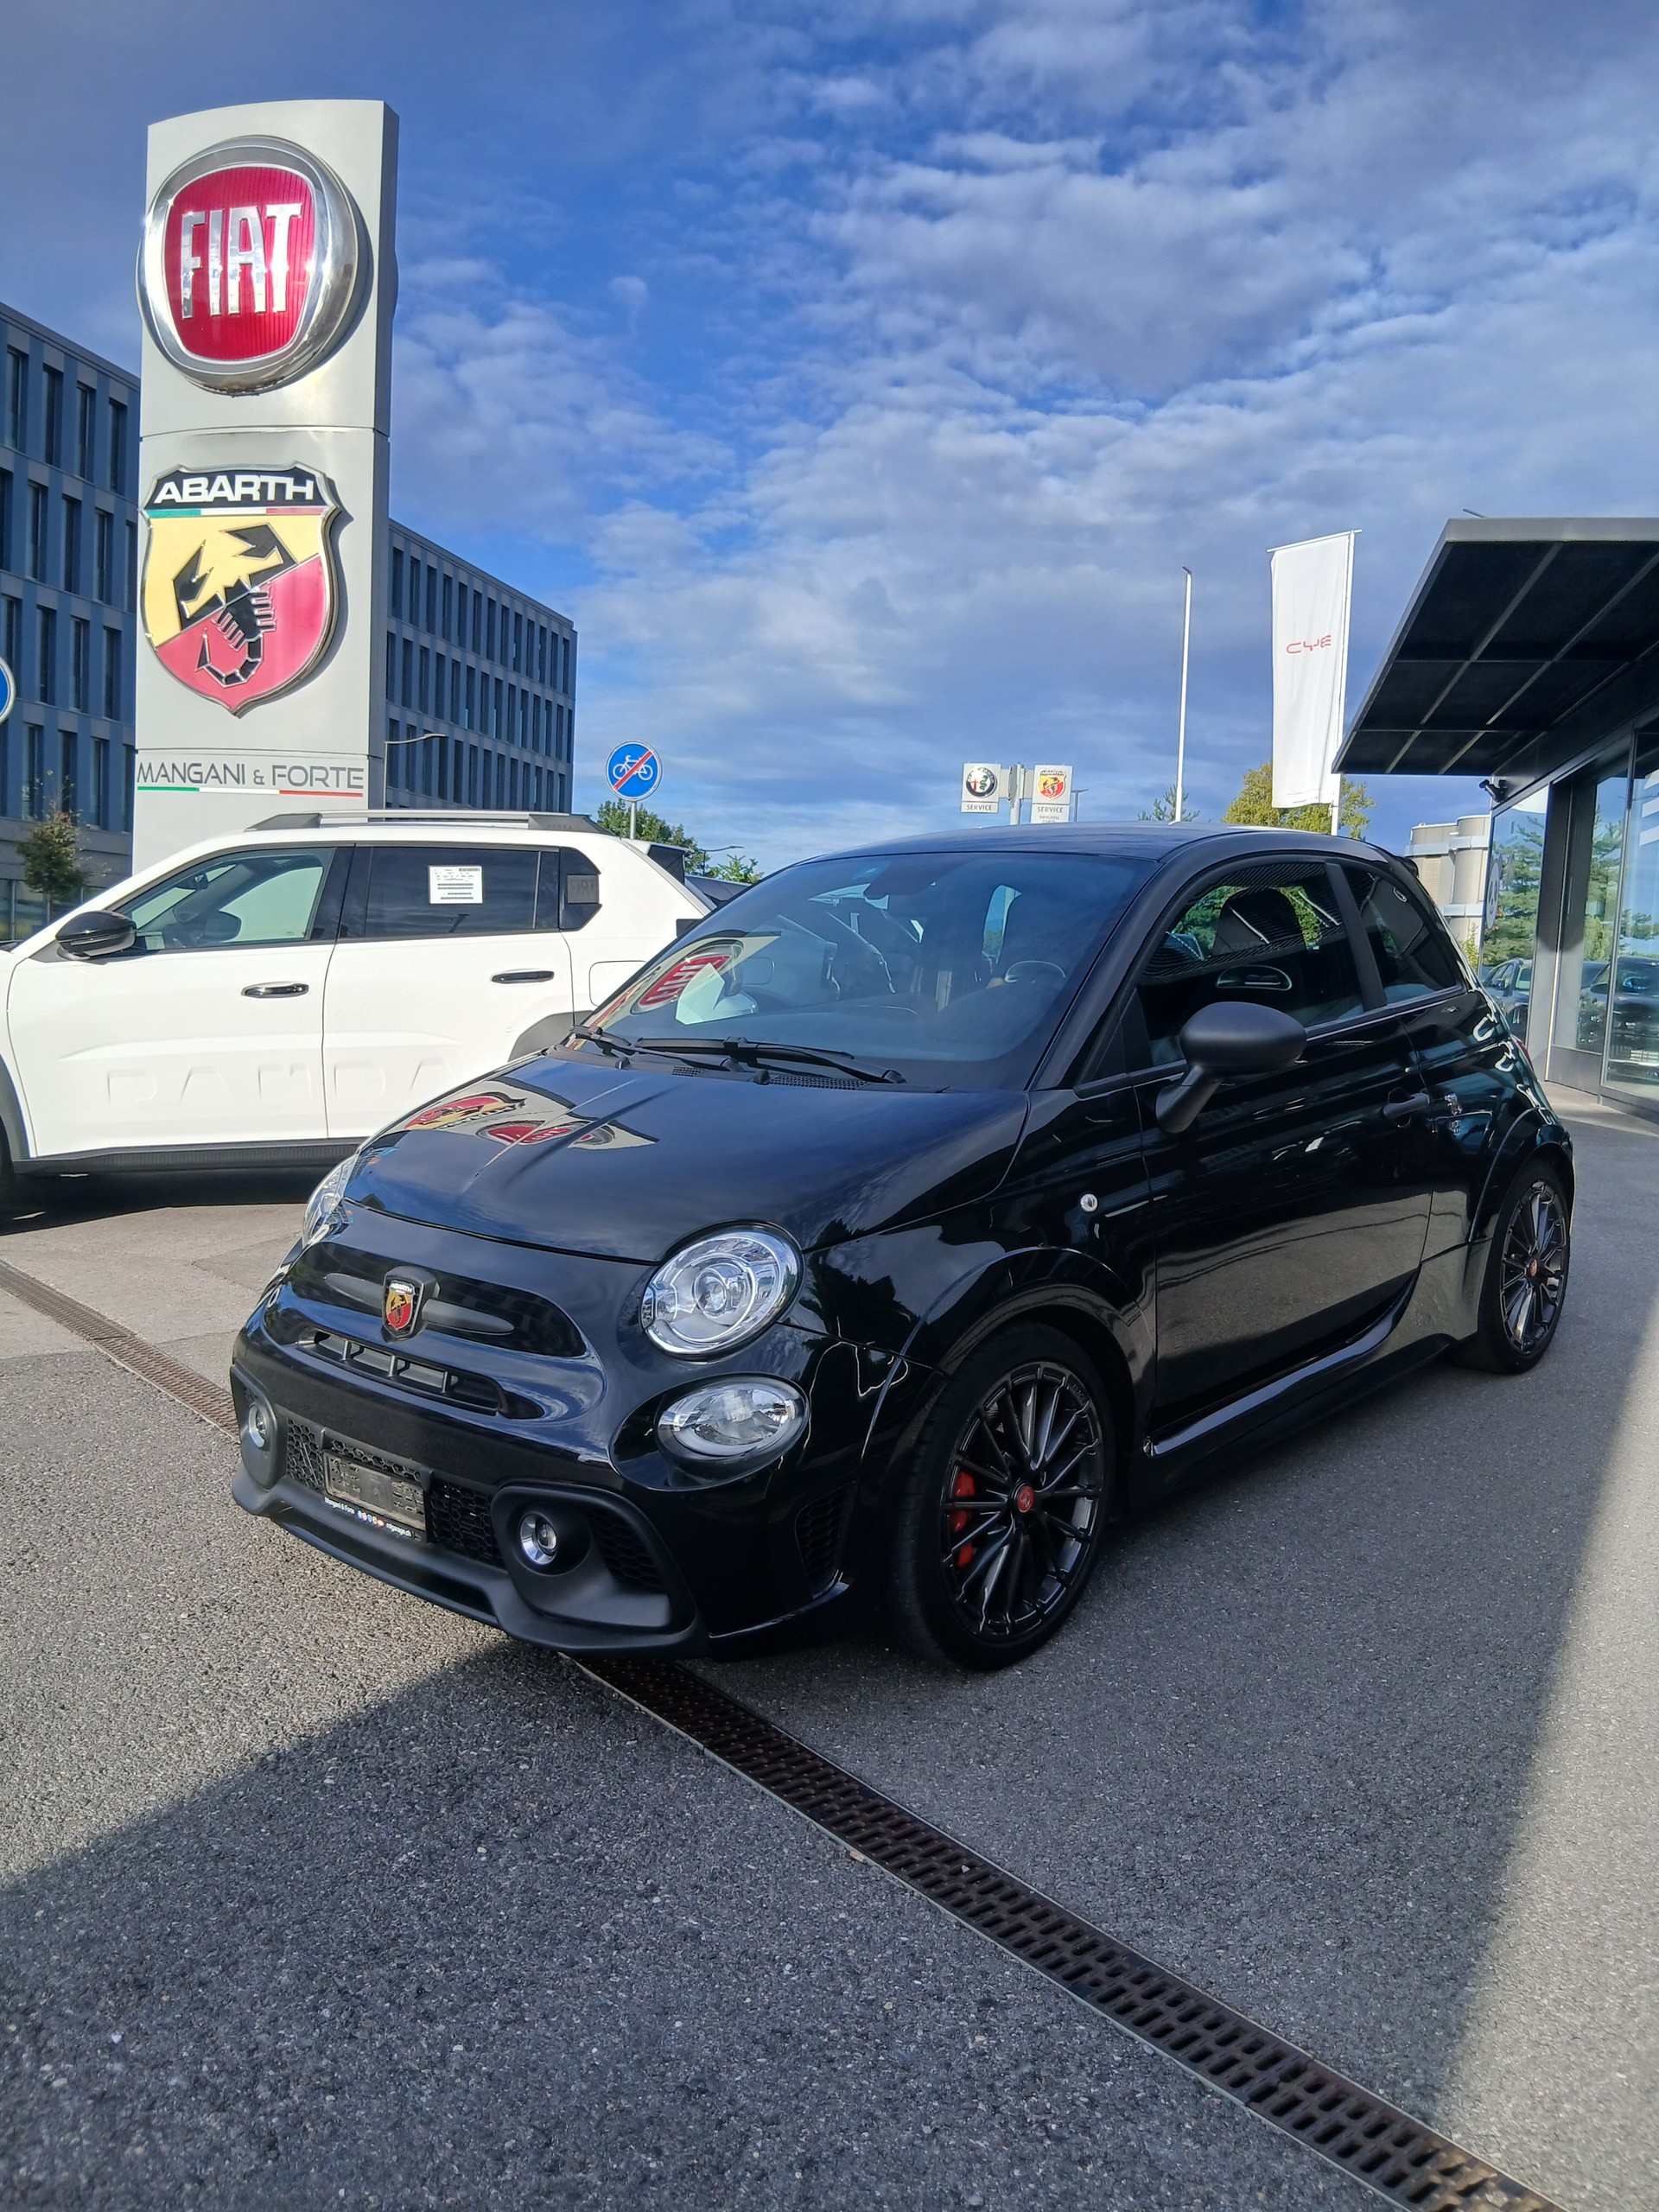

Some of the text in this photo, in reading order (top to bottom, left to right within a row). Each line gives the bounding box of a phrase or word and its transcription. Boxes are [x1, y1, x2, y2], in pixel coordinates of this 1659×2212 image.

[181, 202, 302, 320] FIAT
[153, 474, 315, 505] ABARTH
[137, 761, 365, 790] MANGANI & FORTE
[391, 1282, 413, 1294] ABARTH
